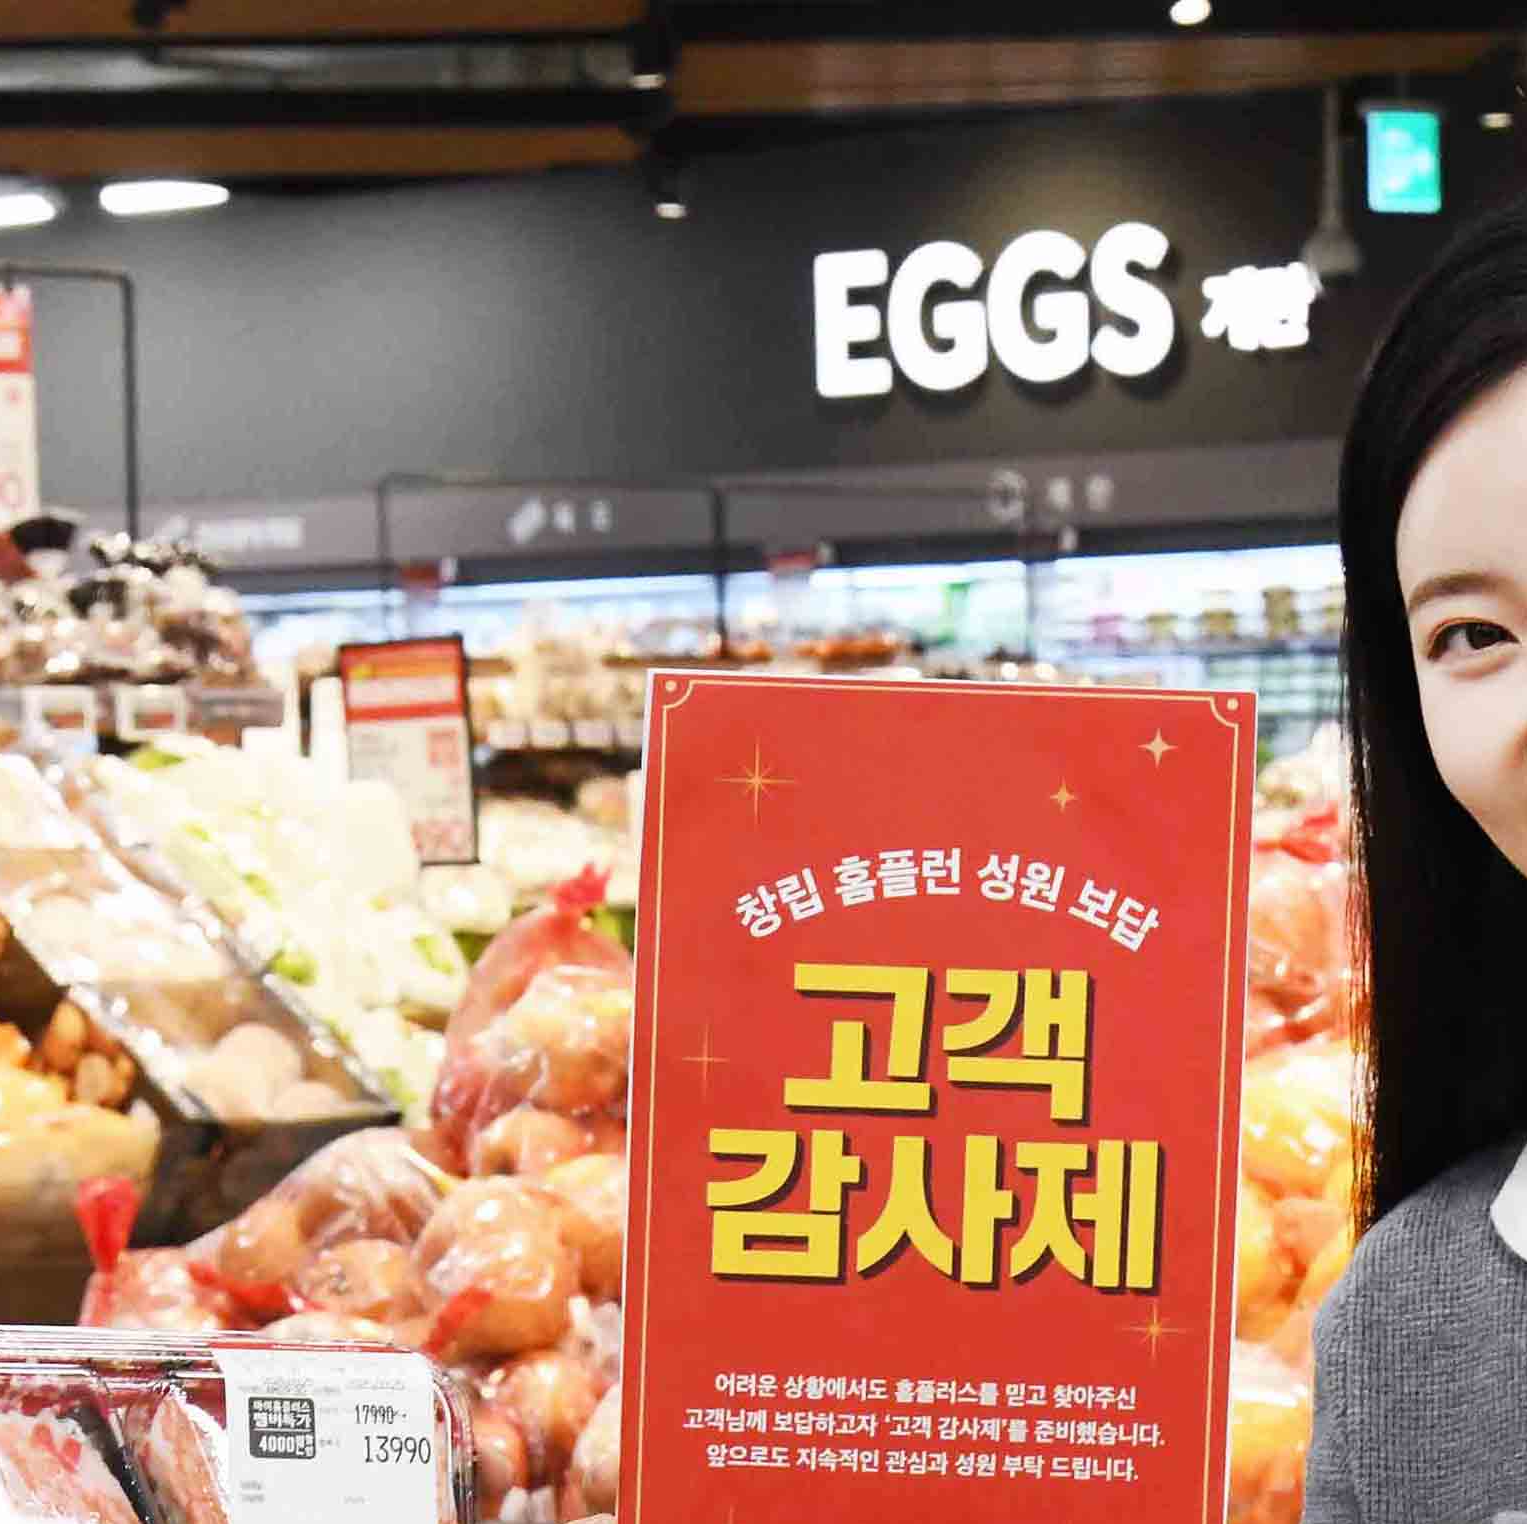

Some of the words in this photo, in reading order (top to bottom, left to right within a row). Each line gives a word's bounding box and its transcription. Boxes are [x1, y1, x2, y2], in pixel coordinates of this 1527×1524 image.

[812, 222, 1177, 399] EGGS
[735, 868, 825, 939] 창립
[833, 848, 961, 904] 홈플런
[977, 853, 1065, 912] 성원
[1067, 879, 1161, 953] 보답
[783, 962, 1093, 1124] 고객
[705, 1127, 1160, 1291] 감사제
[714, 1373, 776, 1398] 어려운
[784, 1375, 888, 1401] 상황에서도
[894, 1380, 997, 1405] 홈플러스를
[1005, 1383, 1043, 1407] 믿고
[1053, 1385, 1136, 1411] 찾아주신
[355, 1404, 394, 1425] 17990
[683, 1408, 767, 1433] 고객님께
[773, 1411, 877, 1436] 보답하고자
[1034, 1420, 1165, 1446] 준비했습니다.
[364, 1436, 431, 1464] 13990
[706, 1445, 790, 1470] 앞으로도
[796, 1447, 879, 1473] 지속적인
[885, 1450, 948, 1475] 관심과
[954, 1453, 997, 1477] 성원
[1002, 1455, 1044, 1478] 부탁
[1049, 1456, 1139, 1481] 드립니다.
